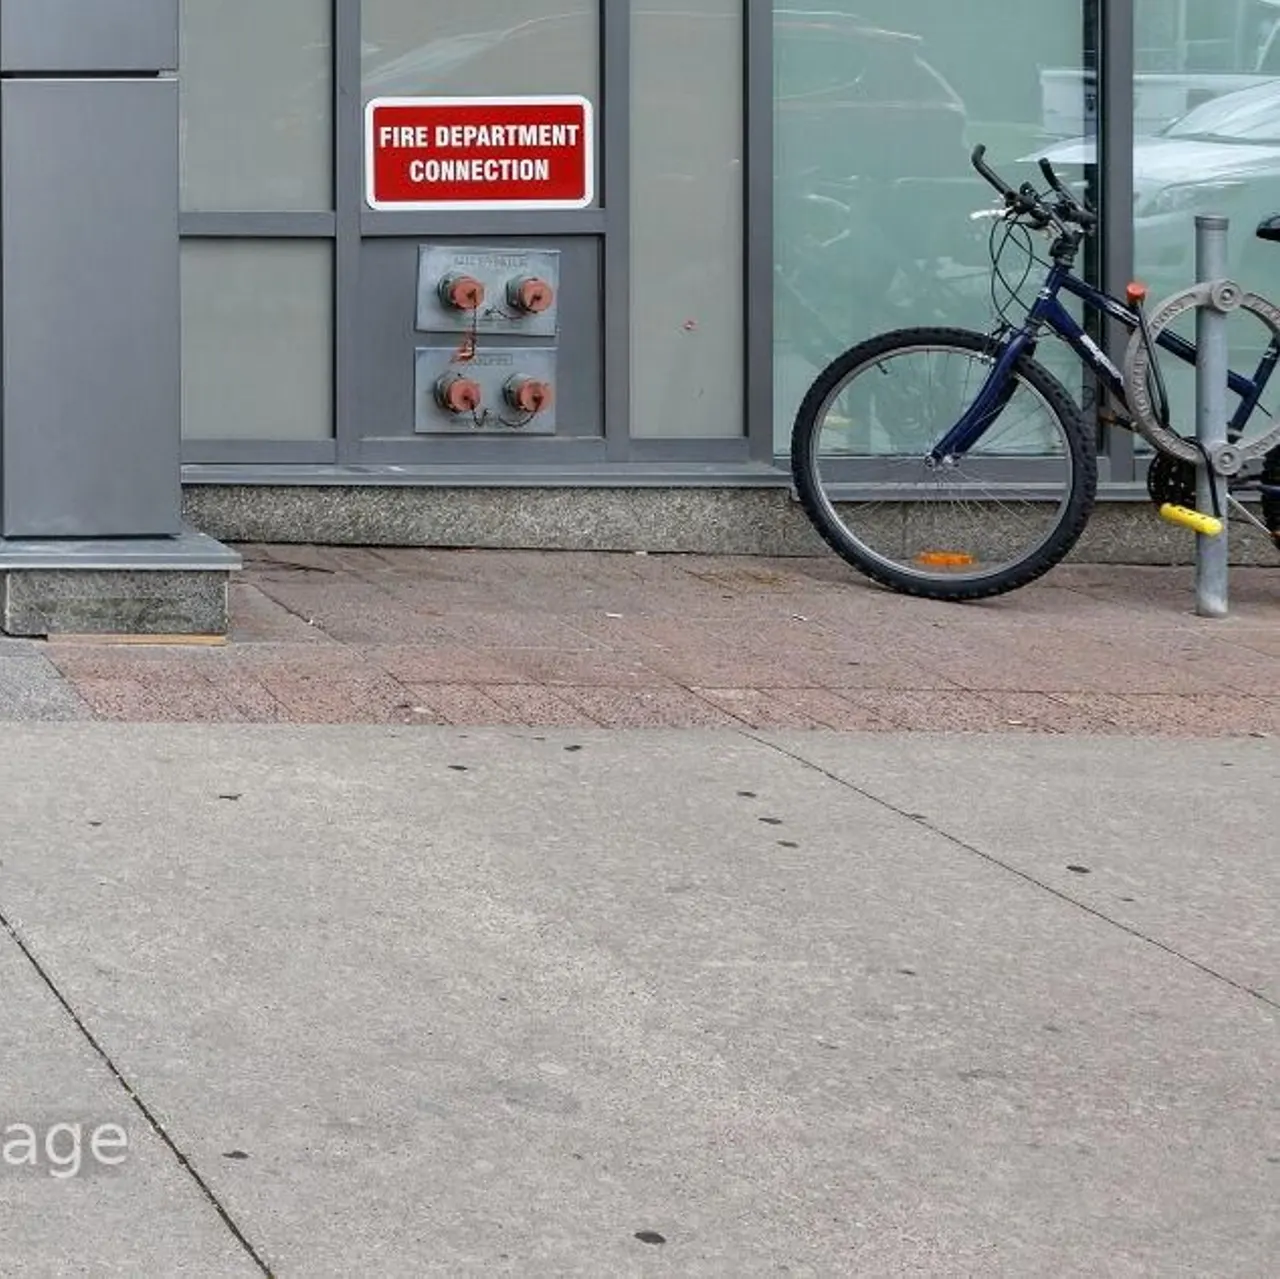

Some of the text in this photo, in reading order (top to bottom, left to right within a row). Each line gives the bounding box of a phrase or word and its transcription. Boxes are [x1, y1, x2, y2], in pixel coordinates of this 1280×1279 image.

[379, 124, 580, 148] FIRE DEPARTMENT
[409, 159, 549, 182] CONNECTION
